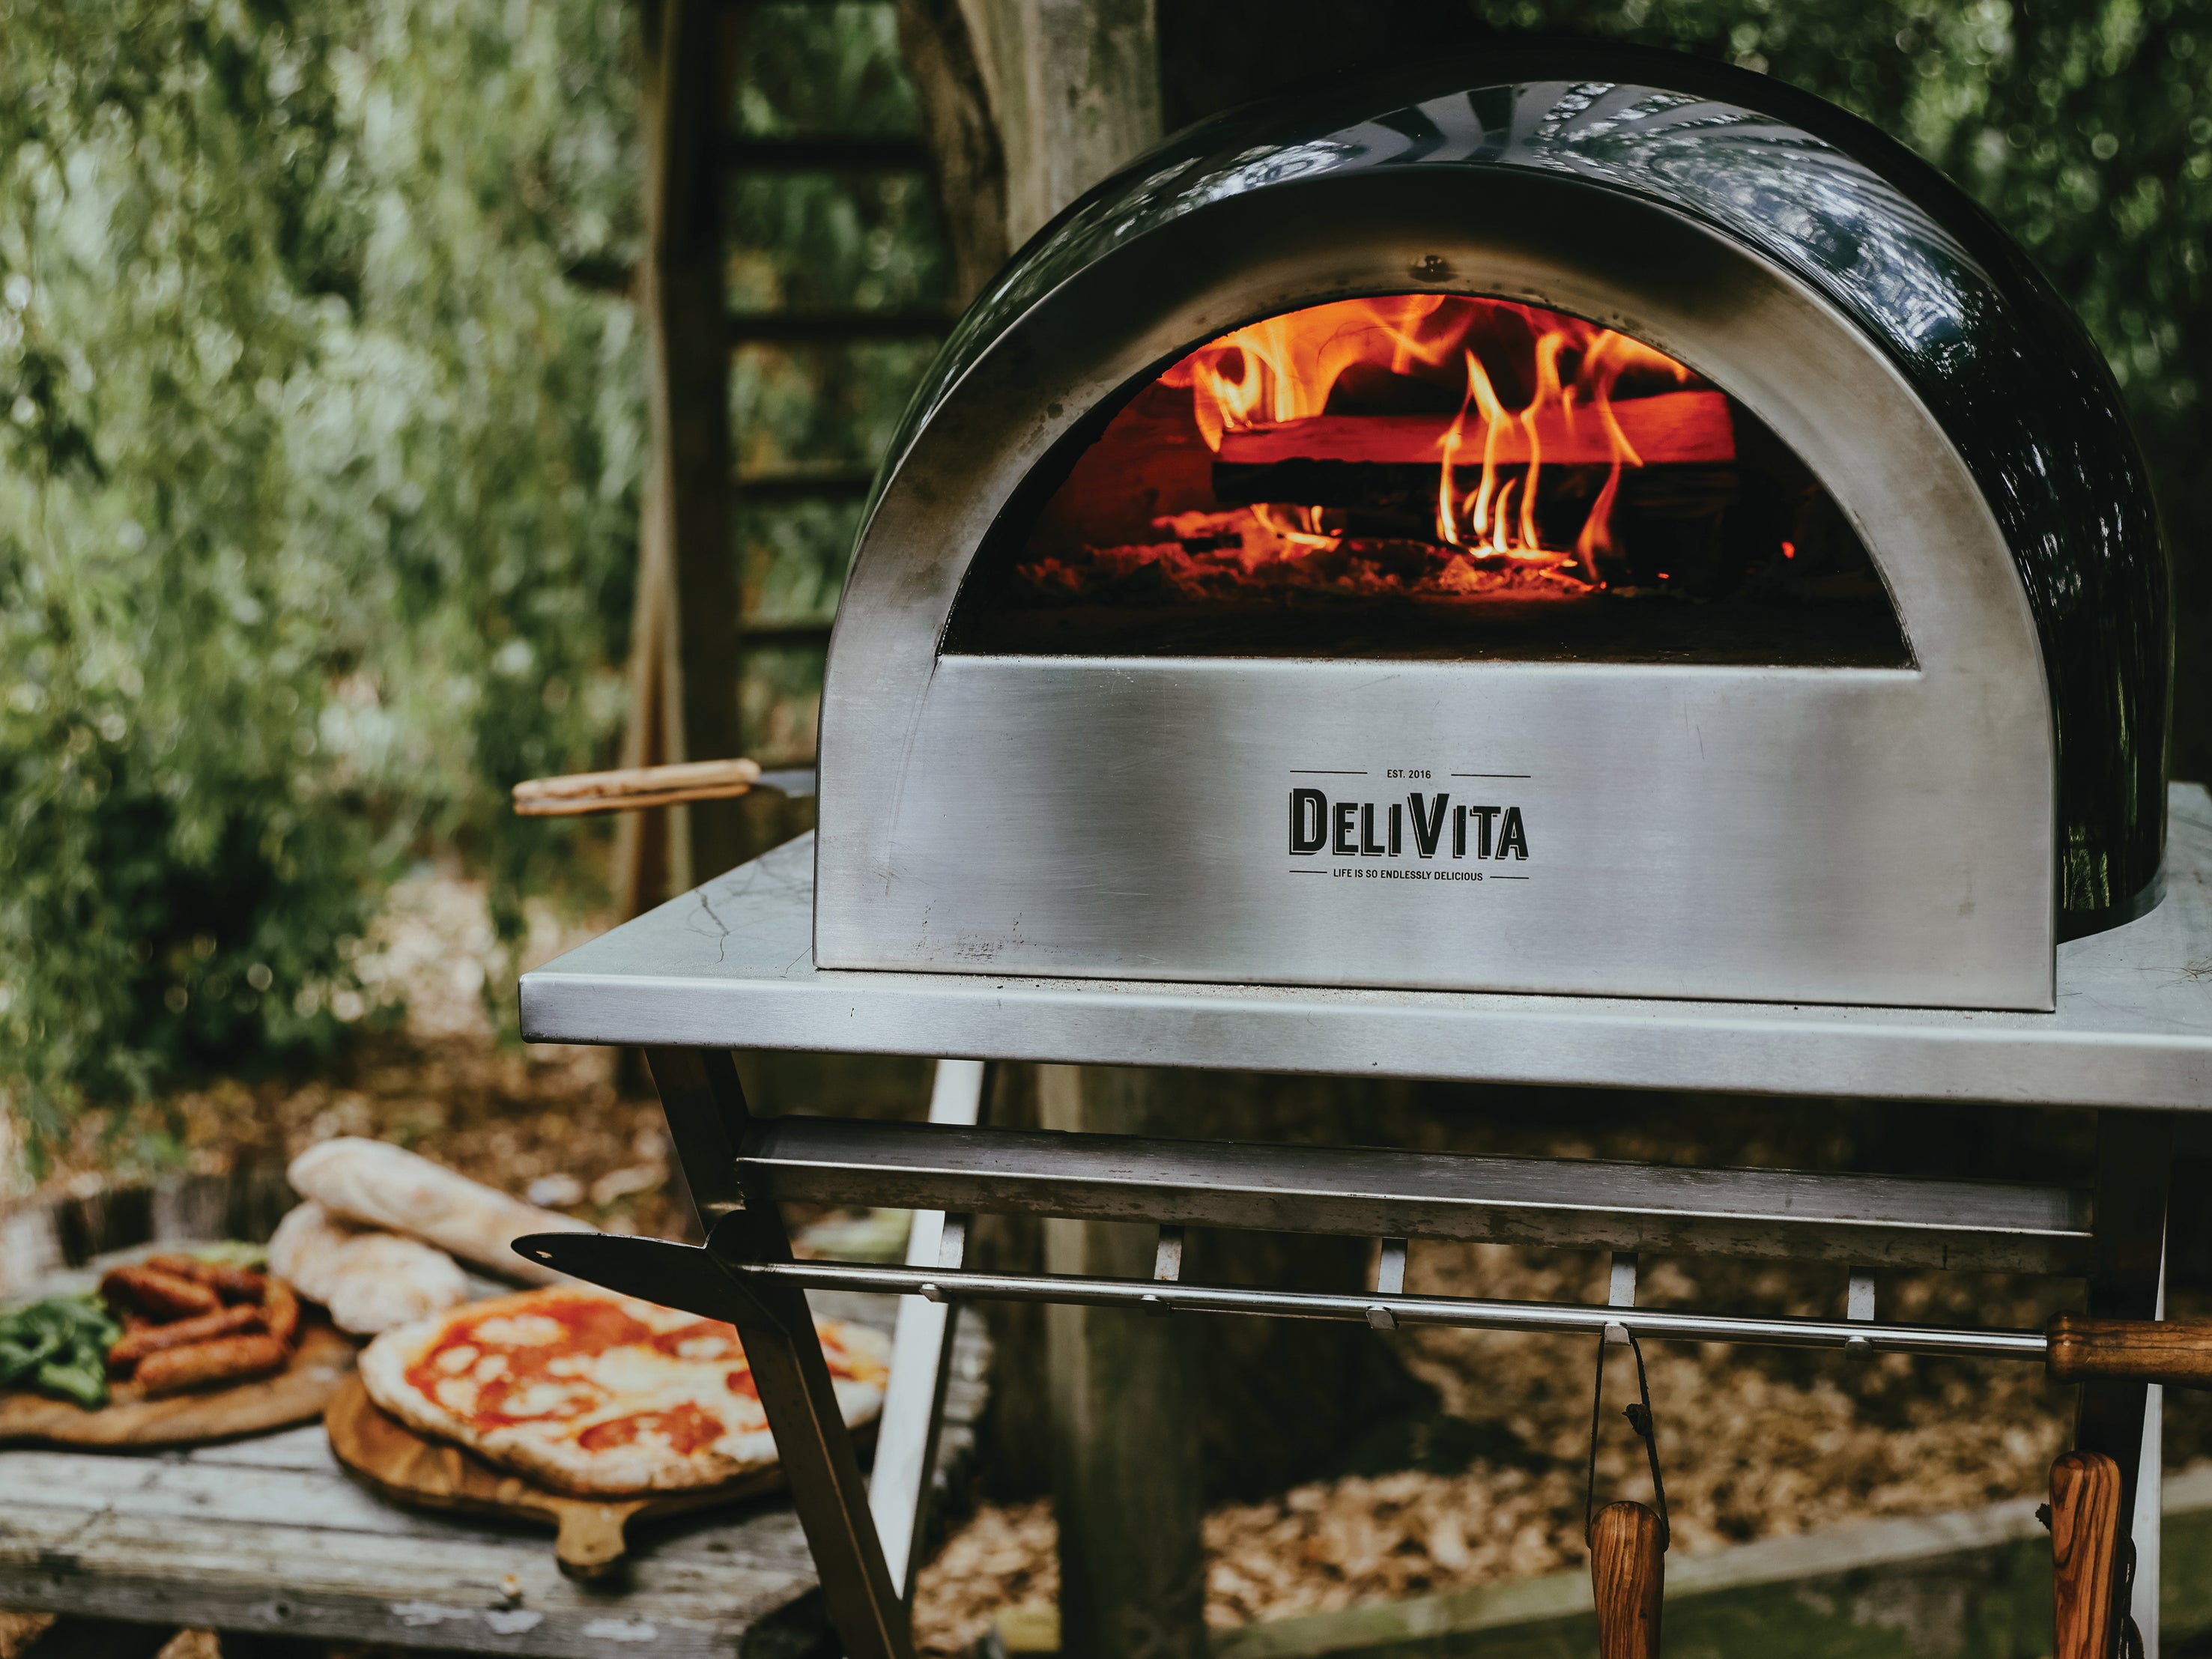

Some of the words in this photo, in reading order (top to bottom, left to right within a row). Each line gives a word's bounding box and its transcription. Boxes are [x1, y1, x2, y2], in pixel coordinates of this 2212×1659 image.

[1387, 769, 1405, 778] EST.
[1408, 770, 1431, 779] 2016
[1333, 868, 1352, 877] LIFE
[1354, 869, 1363, 878] IS
[1366, 870, 1378, 879] SO
[1381, 870, 1431, 880] ENDLESSLY
[1434, 871, 1483, 881] DELICIOUS
